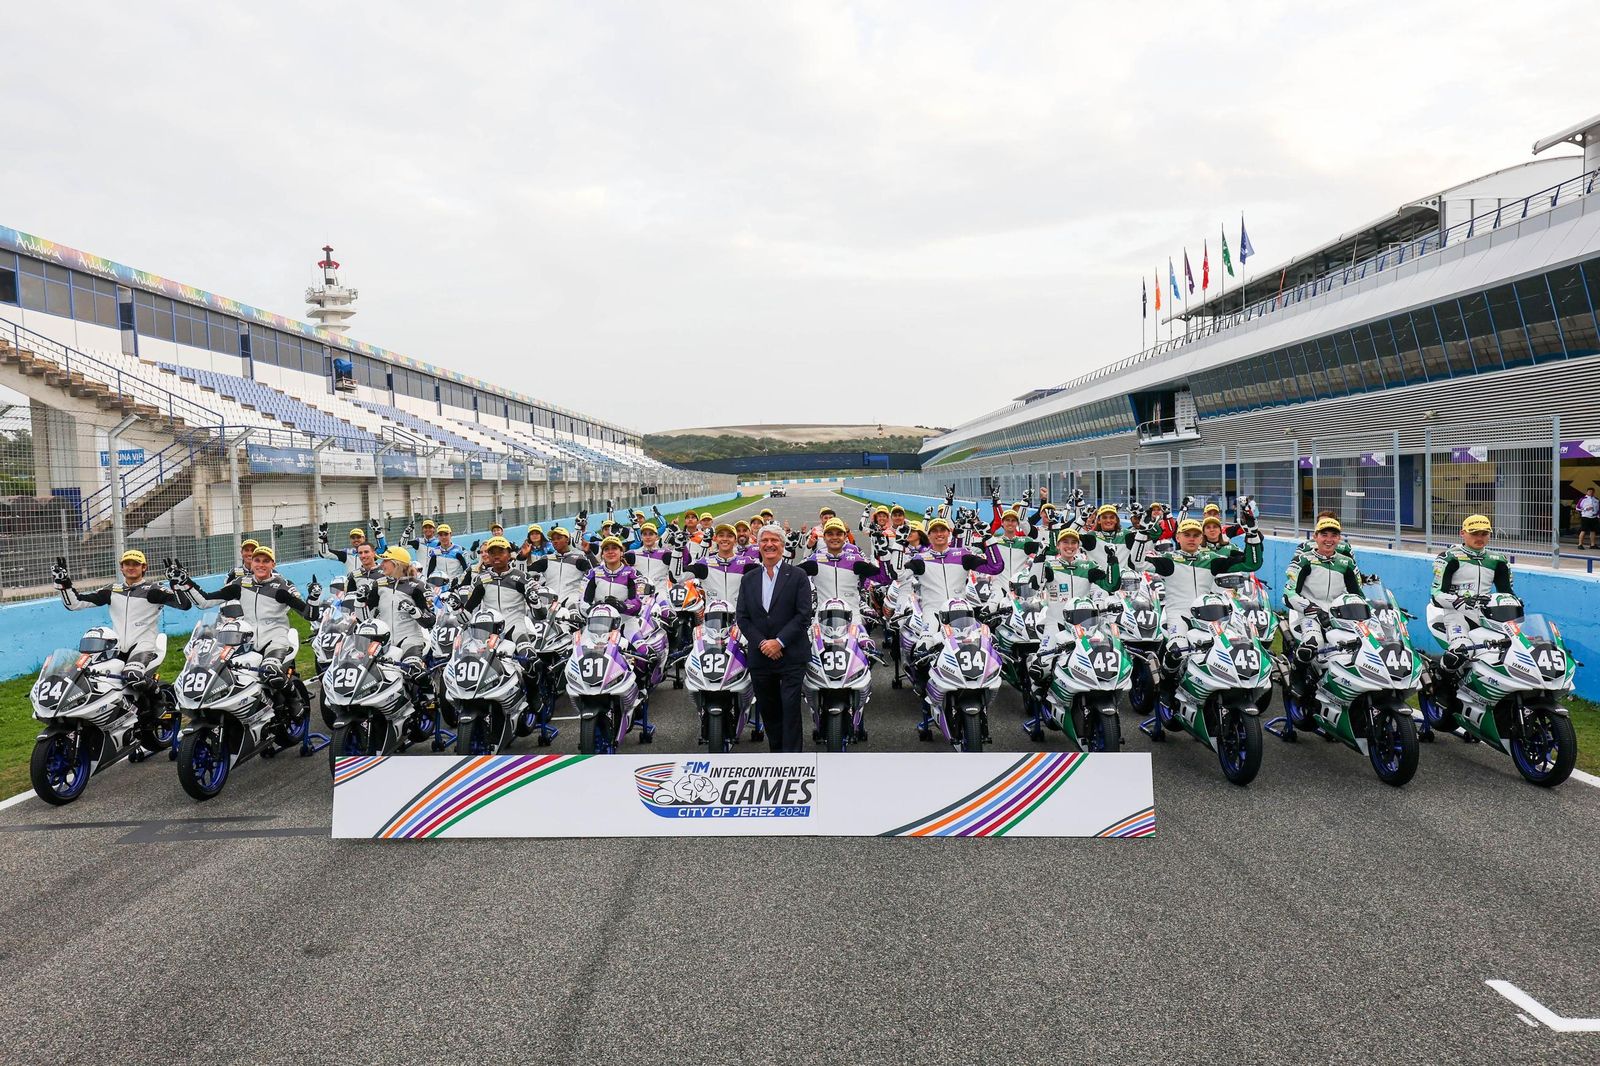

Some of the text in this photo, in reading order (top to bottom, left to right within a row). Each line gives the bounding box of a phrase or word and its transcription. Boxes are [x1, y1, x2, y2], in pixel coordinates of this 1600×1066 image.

[671, 588, 686, 601] 15
[1137, 610, 1154, 625] 47
[322, 632, 342, 648] 27
[438, 627, 456, 641] 21
[193, 638, 213, 653] 25
[582, 658, 604, 678] 31
[702, 653, 726, 673] 32
[823, 651, 847, 671] 33
[960, 651, 984, 671] 34
[1093, 651, 1118, 672] 42
[1213, 662, 1229, 673] YAMAHA
[1234, 649, 1260, 670] 43
[1362, 663, 1380, 673] YAMAHA
[1385, 650, 1412, 670] 44
[1511, 662, 1530, 673] YAMAHA
[1537, 649, 1565, 671] 45
[333, 668, 358, 688] 29
[456, 661, 480, 682] 30
[40, 681, 63, 700] 24
[183, 673, 208, 692] 28
[683, 761, 816, 778] FIM INTERCONTINENTAL
[720, 779, 815, 805] GAMES
[678, 807, 807, 817] CITY OF JEREZ 2024
